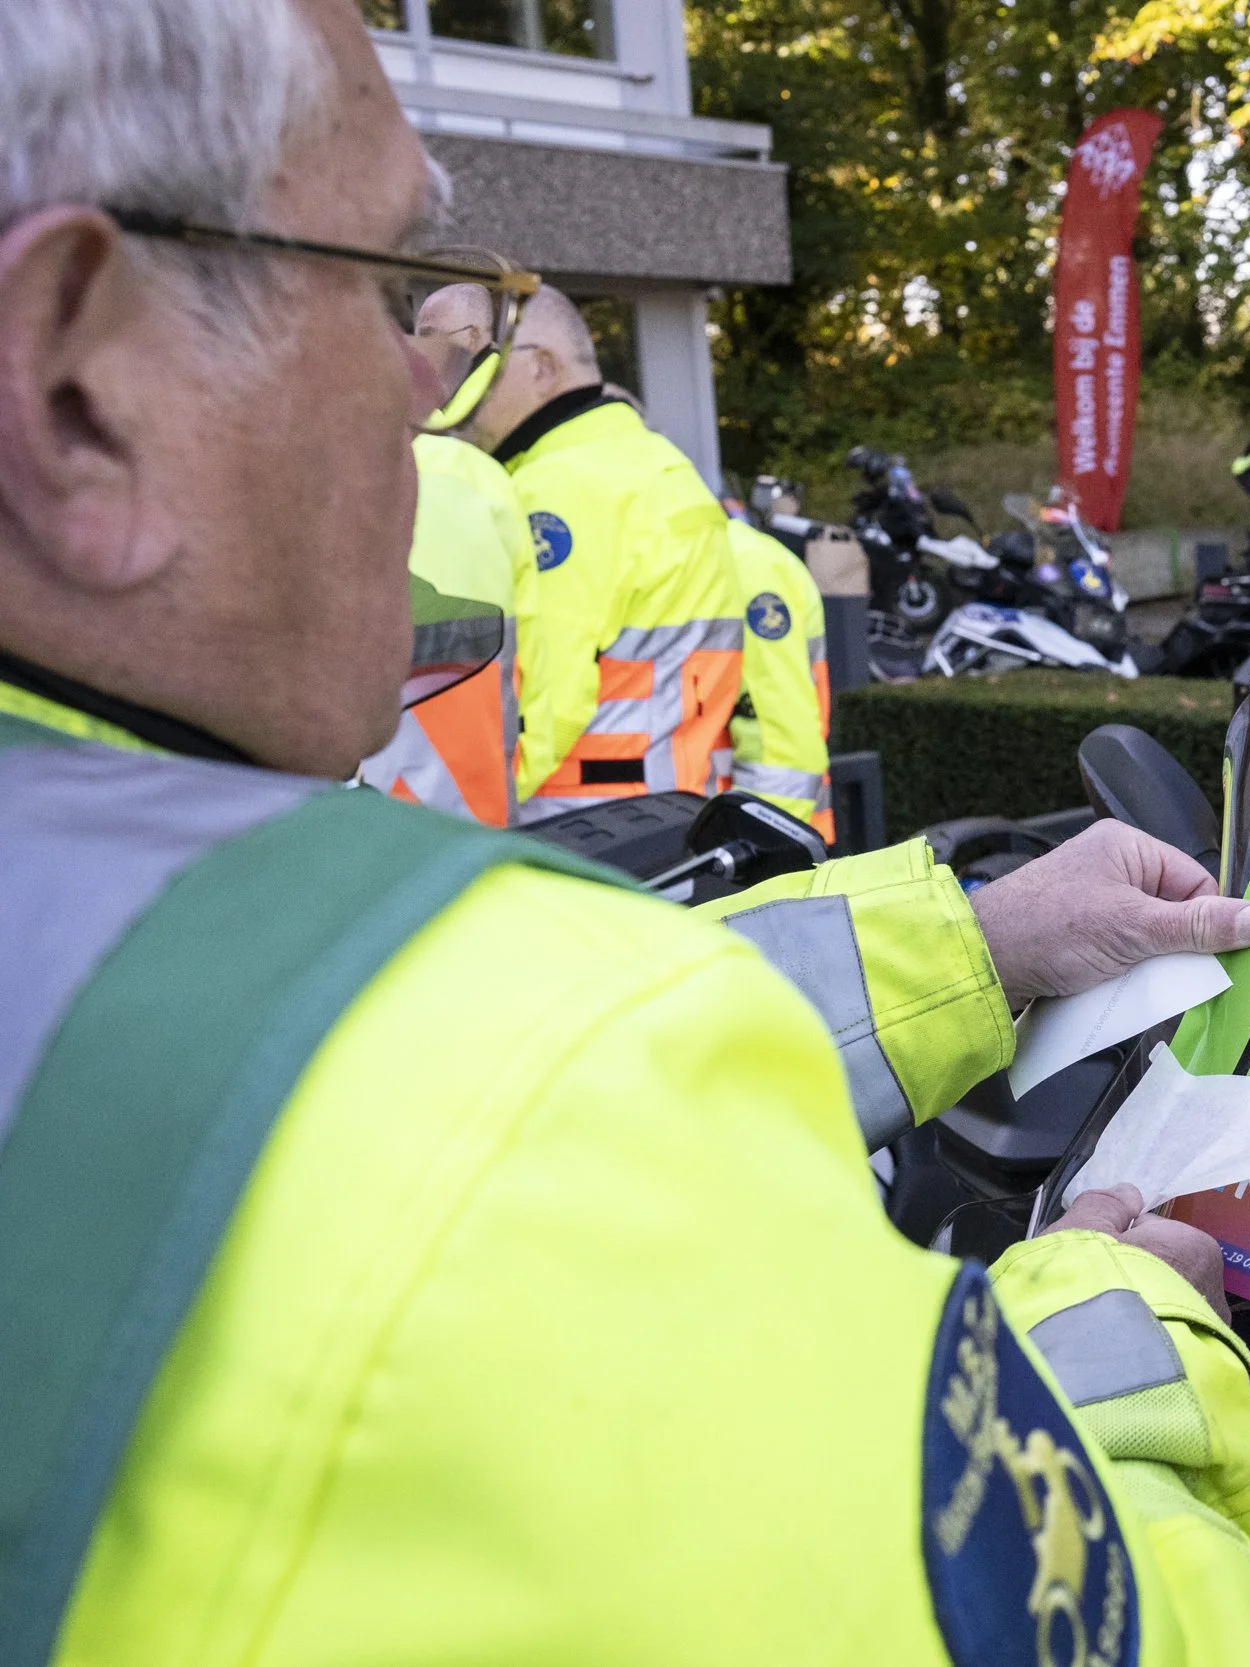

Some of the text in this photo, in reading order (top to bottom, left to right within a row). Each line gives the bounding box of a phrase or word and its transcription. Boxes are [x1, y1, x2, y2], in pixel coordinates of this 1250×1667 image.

[1069, 299, 1099, 475] Welkom bij de
